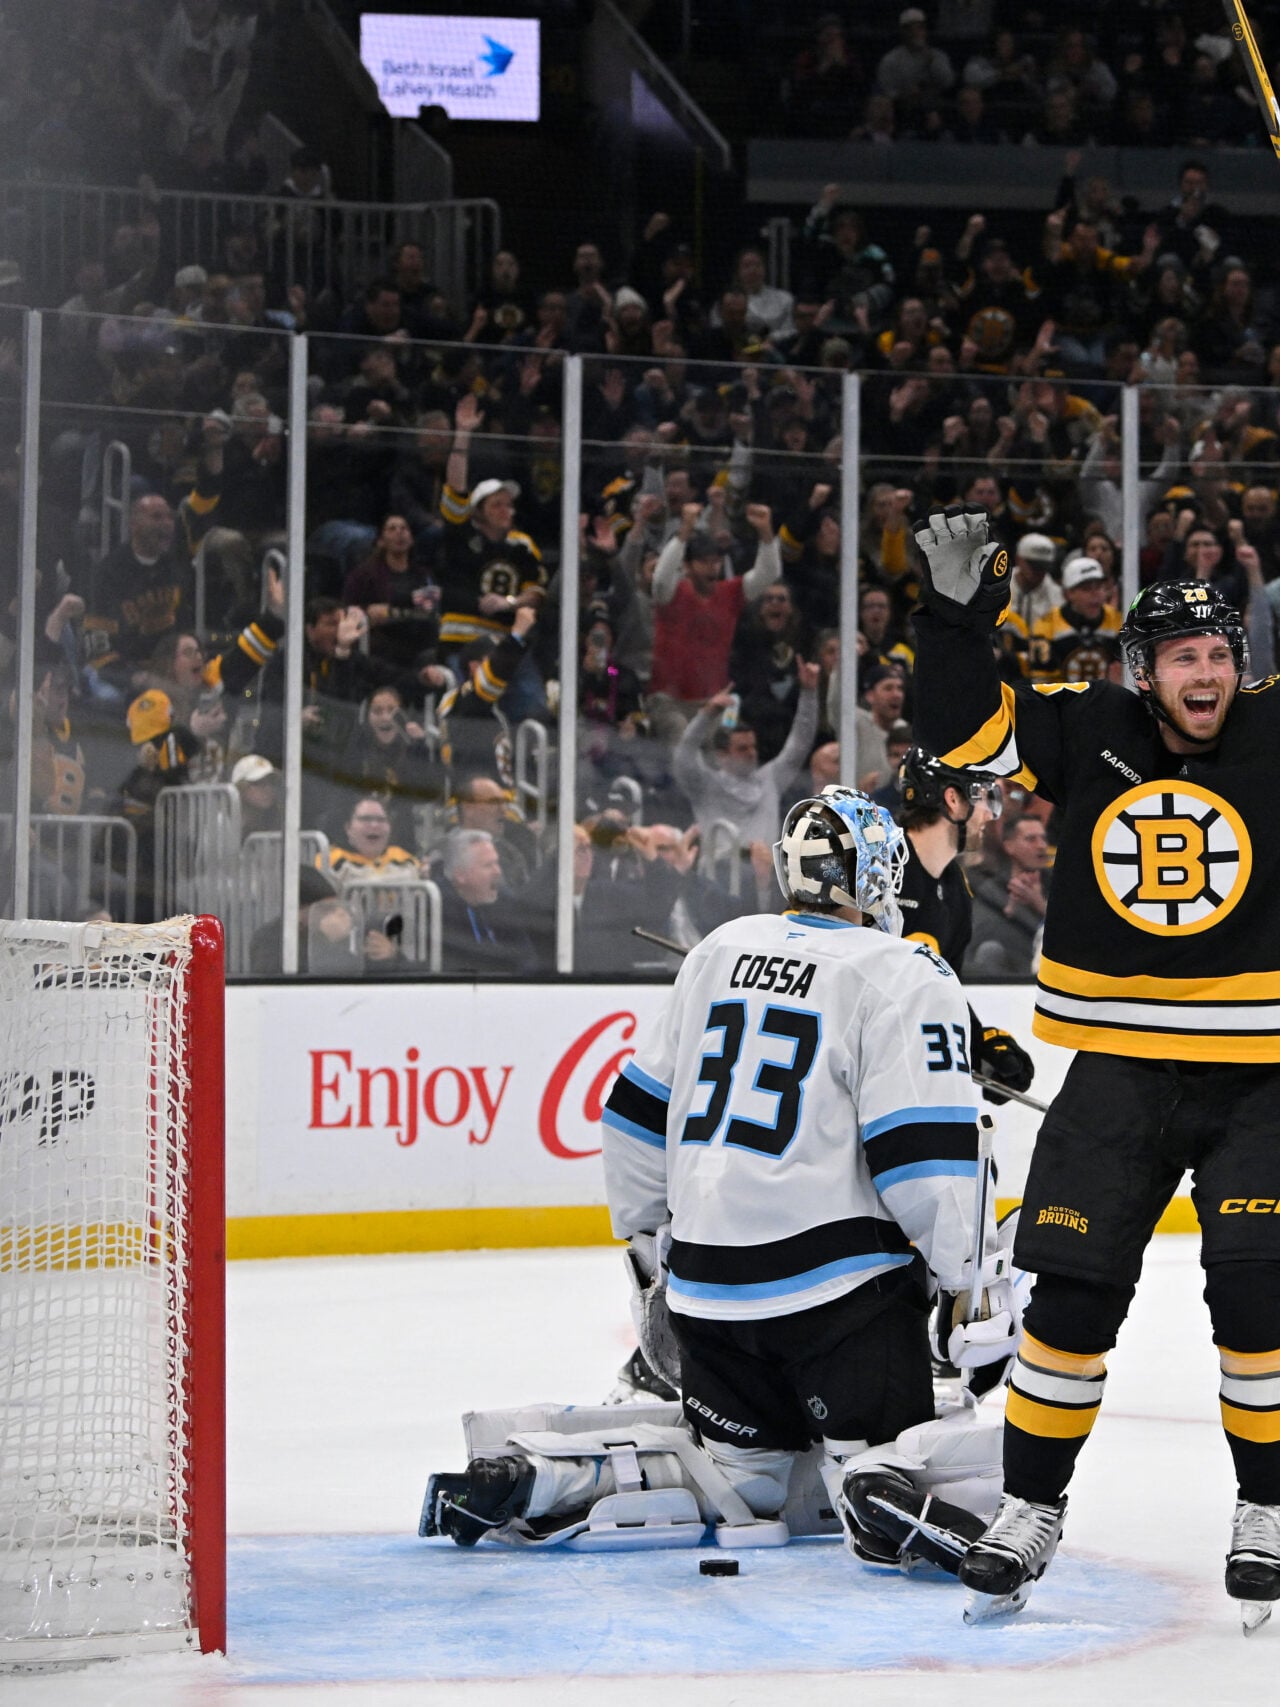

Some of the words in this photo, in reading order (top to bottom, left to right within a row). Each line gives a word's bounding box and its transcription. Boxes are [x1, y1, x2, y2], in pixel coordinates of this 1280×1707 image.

[382, 60, 422, 76] Beth
[429, 61, 475, 78] Israel
[439, 82, 497, 99] Health
[1182, 587, 1209, 604] 28
[1133, 816, 1208, 902] B
[729, 953, 818, 999] COSSA
[920, 1022, 972, 1075] 33
[307, 1046, 515, 1148] Enjoy
[680, 999, 823, 1161] 33
[1036, 1208, 1089, 1235] BRUINS
[1047, 1206, 1081, 1217] BOSTON
[685, 1396, 759, 1438] BAUER
